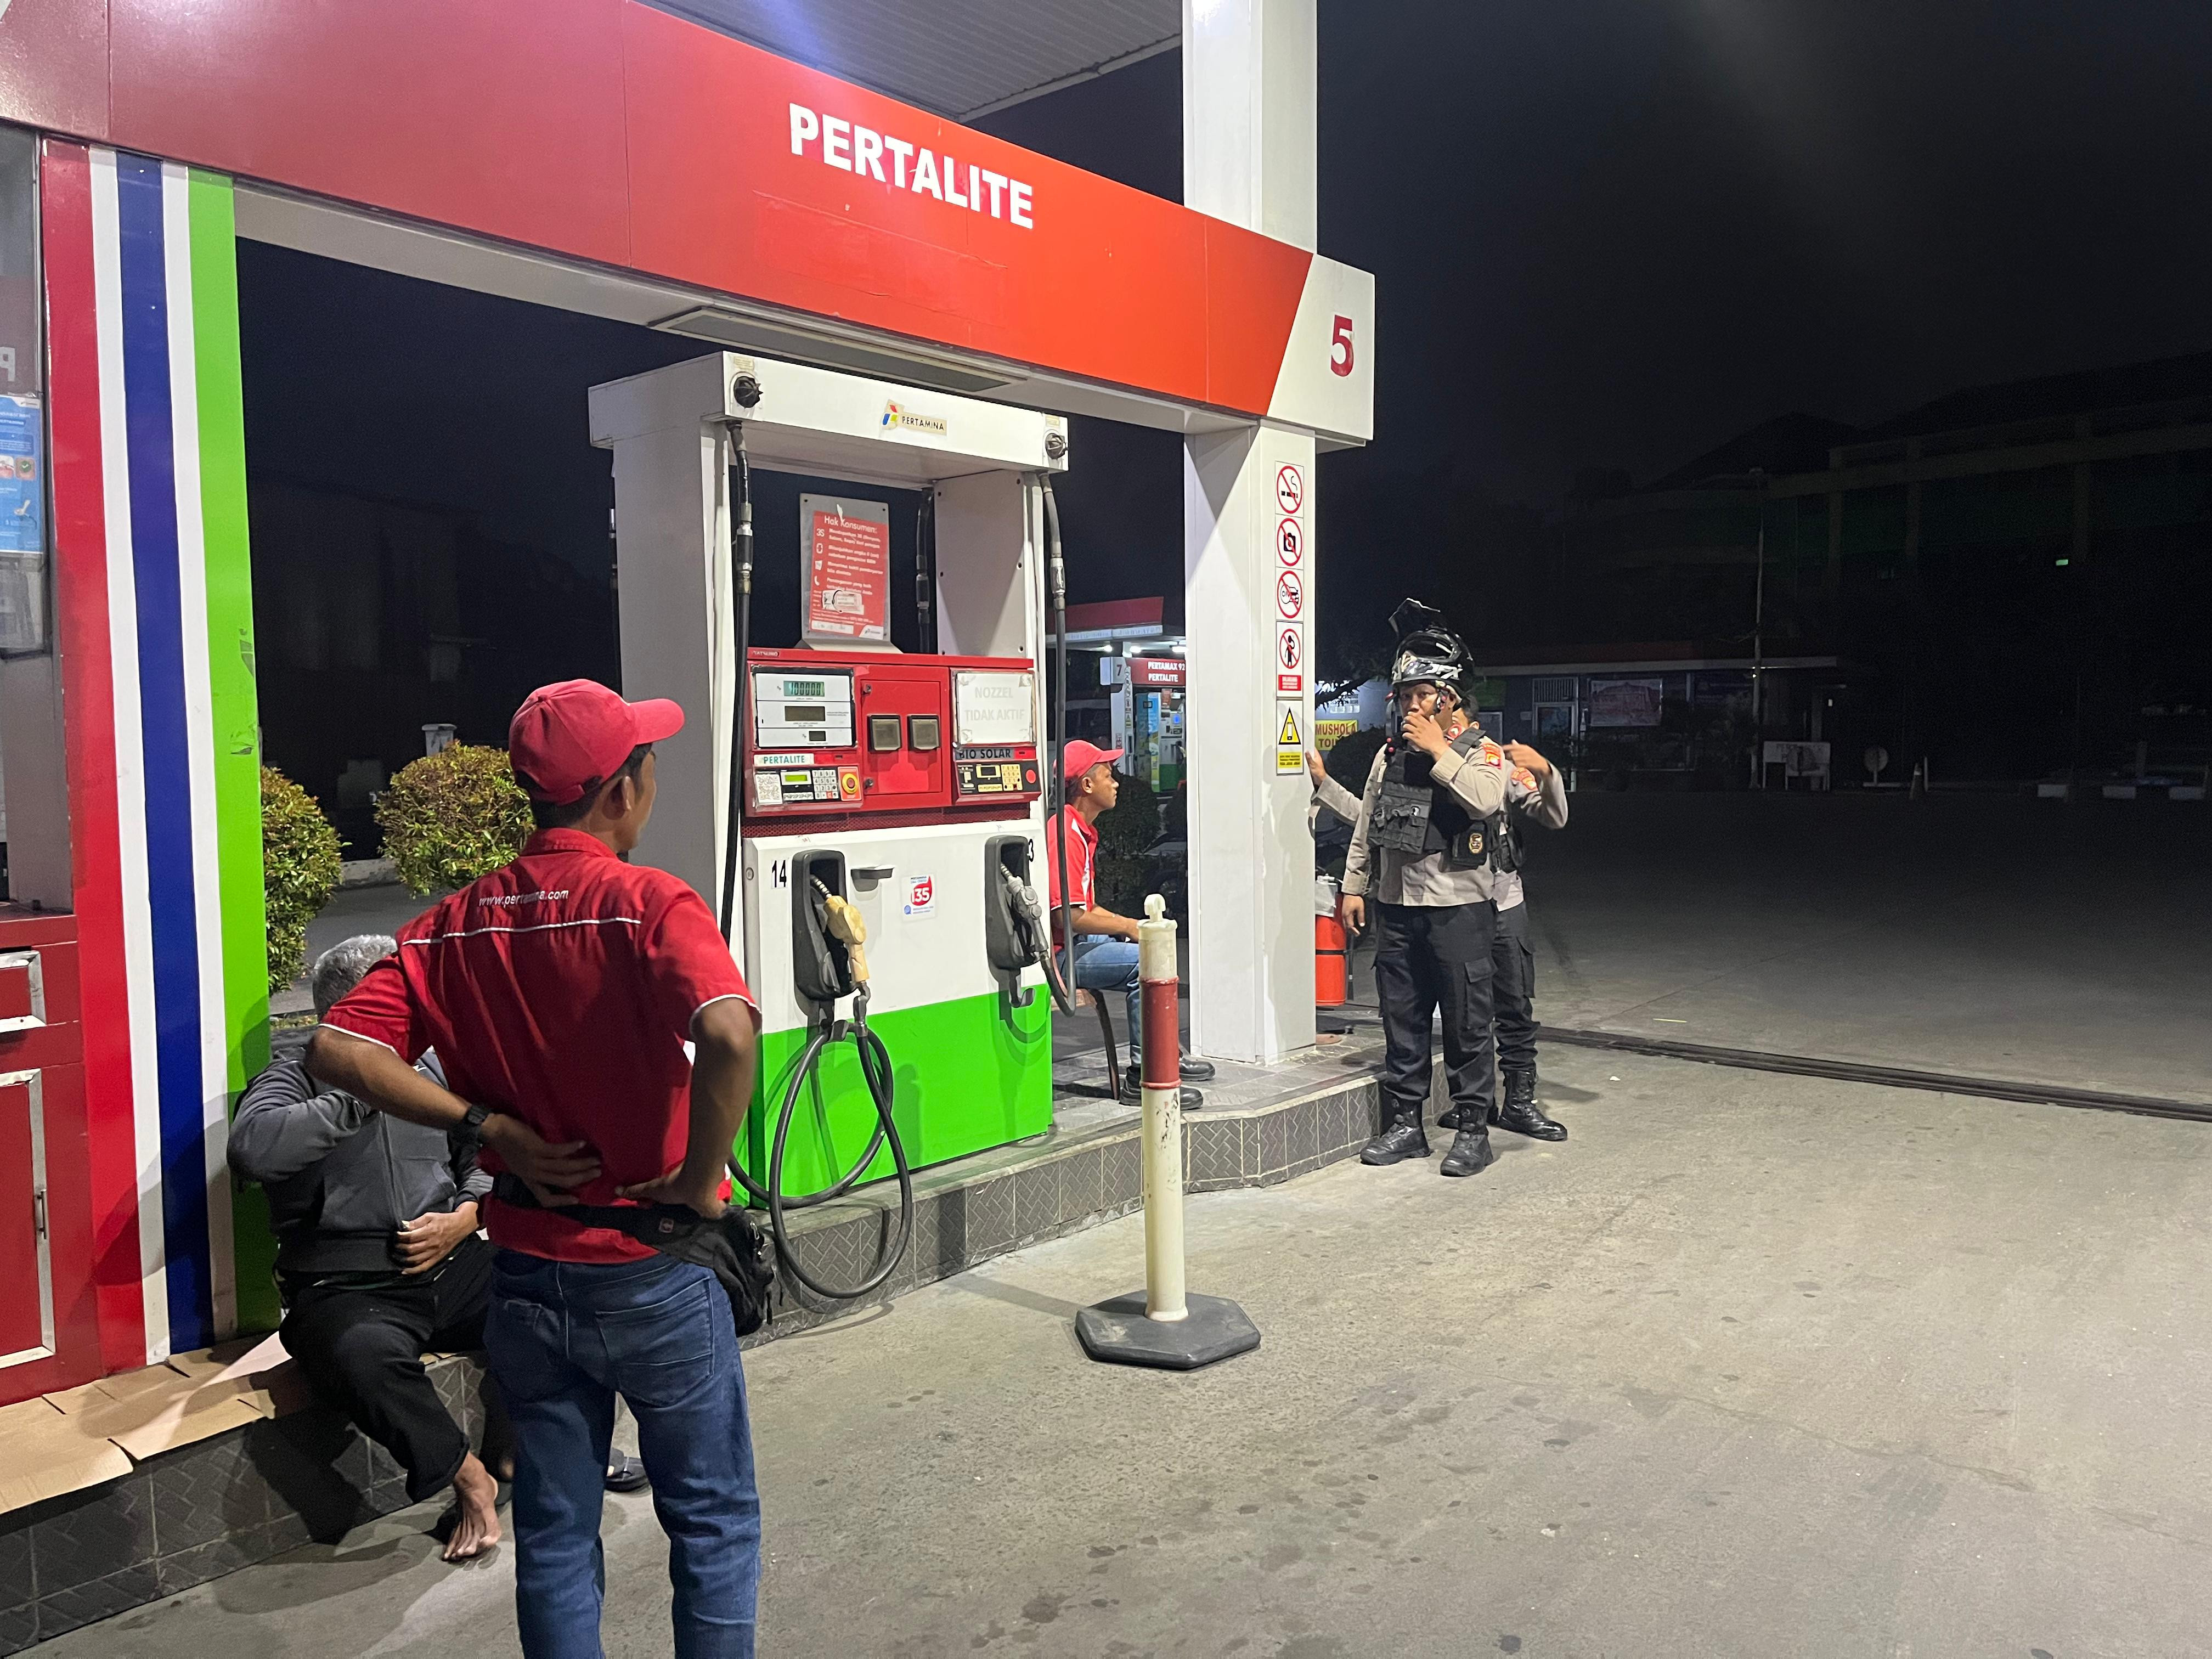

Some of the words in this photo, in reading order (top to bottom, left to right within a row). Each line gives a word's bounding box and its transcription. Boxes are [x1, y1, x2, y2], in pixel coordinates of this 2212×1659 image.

[789, 103, 1033, 229] PERTALITE
[1331, 314, 1354, 377] 5
[902, 416, 944, 430] PERTAMINA
[824, 515, 839, 526] Hak
[1116, 664, 1122, 676] 7
[1148, 661, 1178, 670] PERTAMAX
[1178, 663, 1185, 671] 92
[1148, 673, 1178, 682] PERTALITE
[975, 687, 1014, 698] NOZZEL
[964, 709, 994, 721] TIDAK
[996, 708, 1026, 720] AKTIF
[1315, 723, 1356, 735] MUSHOLA
[763, 755, 805, 764] PERTALITE
[960, 749, 977, 760] BIO
[980, 748, 1011, 759] SOLAR
[771, 860, 787, 888] 14
[911, 887, 930, 904] 135
